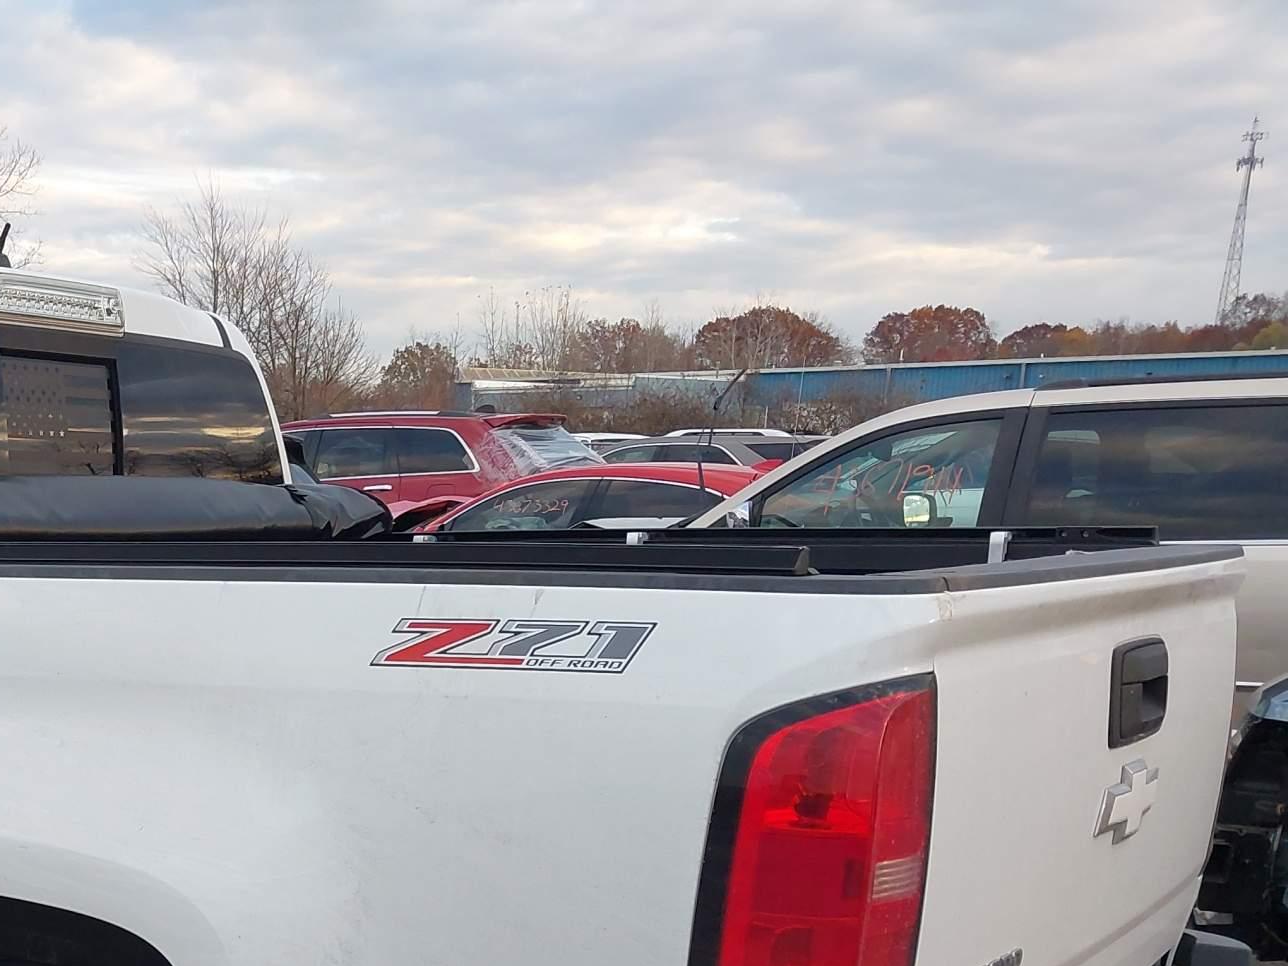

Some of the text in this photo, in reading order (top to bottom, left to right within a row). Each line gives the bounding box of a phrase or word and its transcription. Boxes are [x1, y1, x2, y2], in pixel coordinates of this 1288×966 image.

[369, 618, 658, 674] Z71
[526, 658, 623, 670] OFF ROAD
